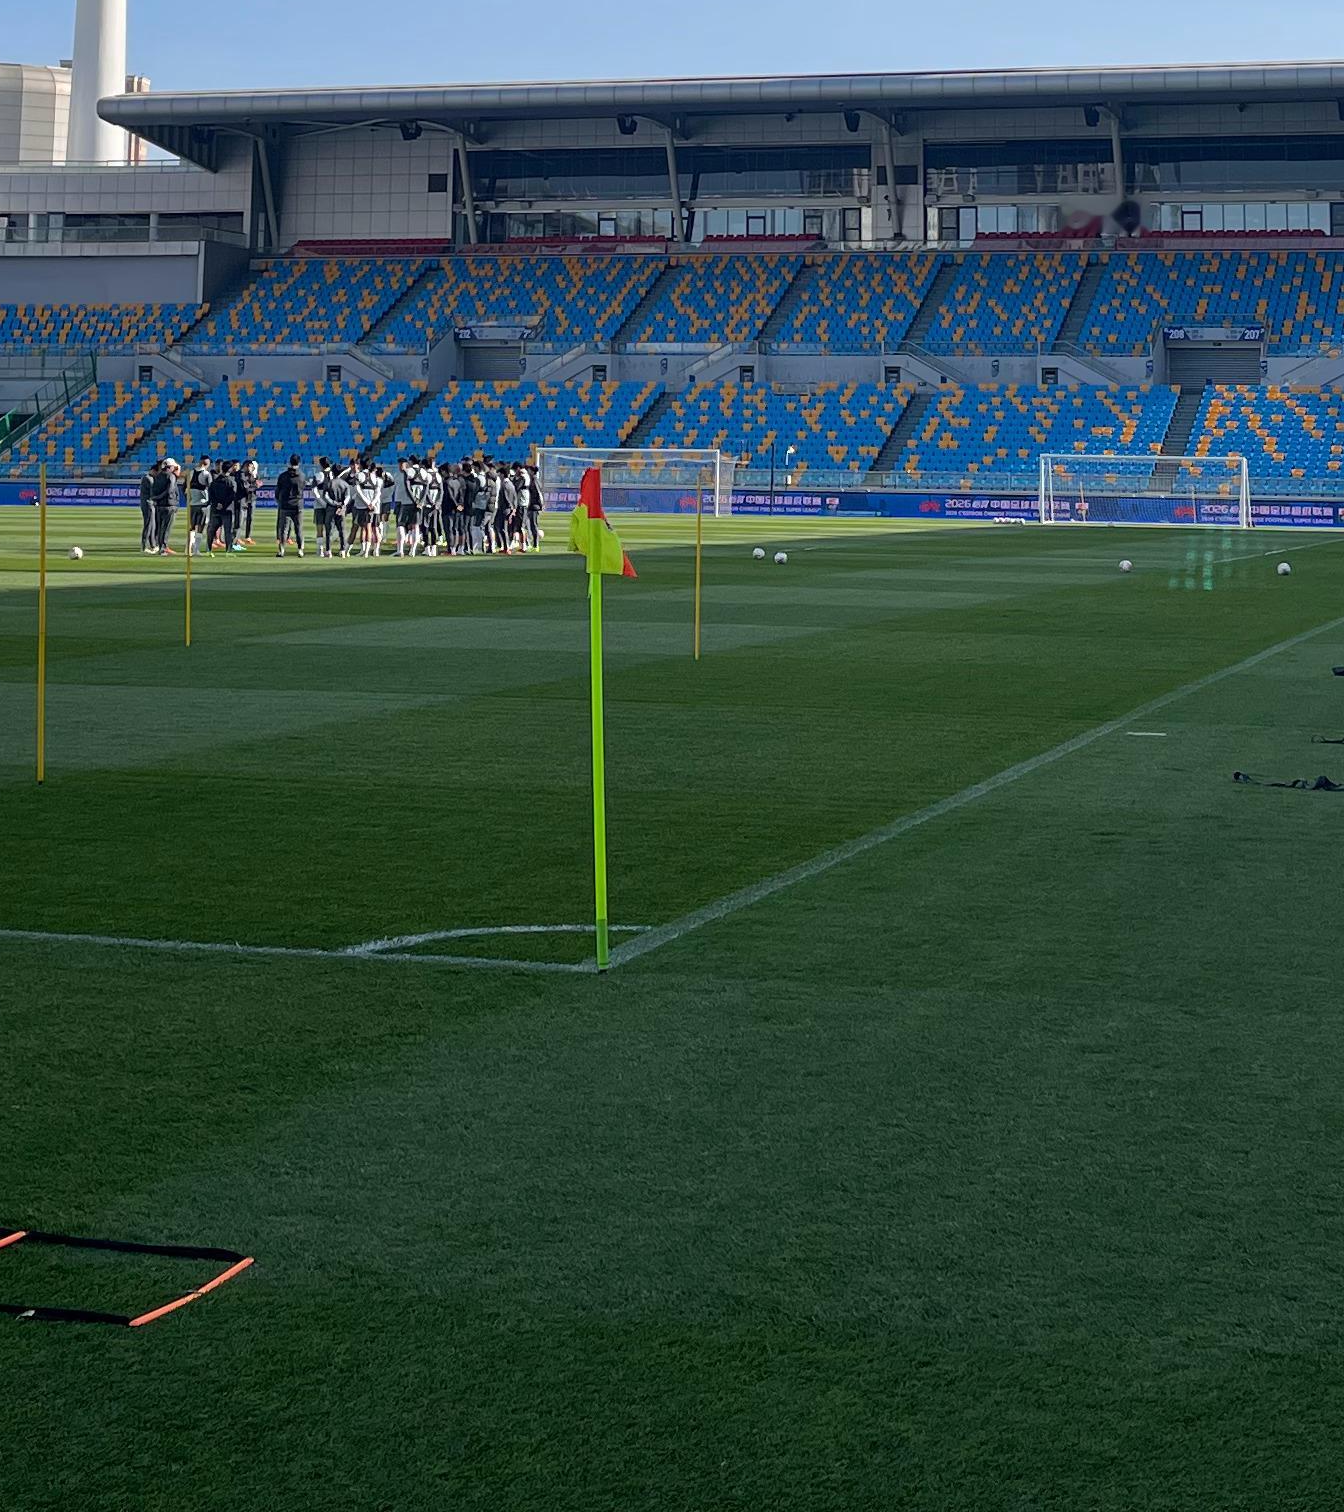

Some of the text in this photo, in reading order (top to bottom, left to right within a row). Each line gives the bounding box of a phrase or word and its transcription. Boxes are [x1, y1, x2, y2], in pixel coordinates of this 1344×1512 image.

[1244, 329, 1260, 340] 207
[46, 488, 63, 496] 026
[944, 499, 971, 508] 2026
[1200, 505, 1229, 514] 2026
